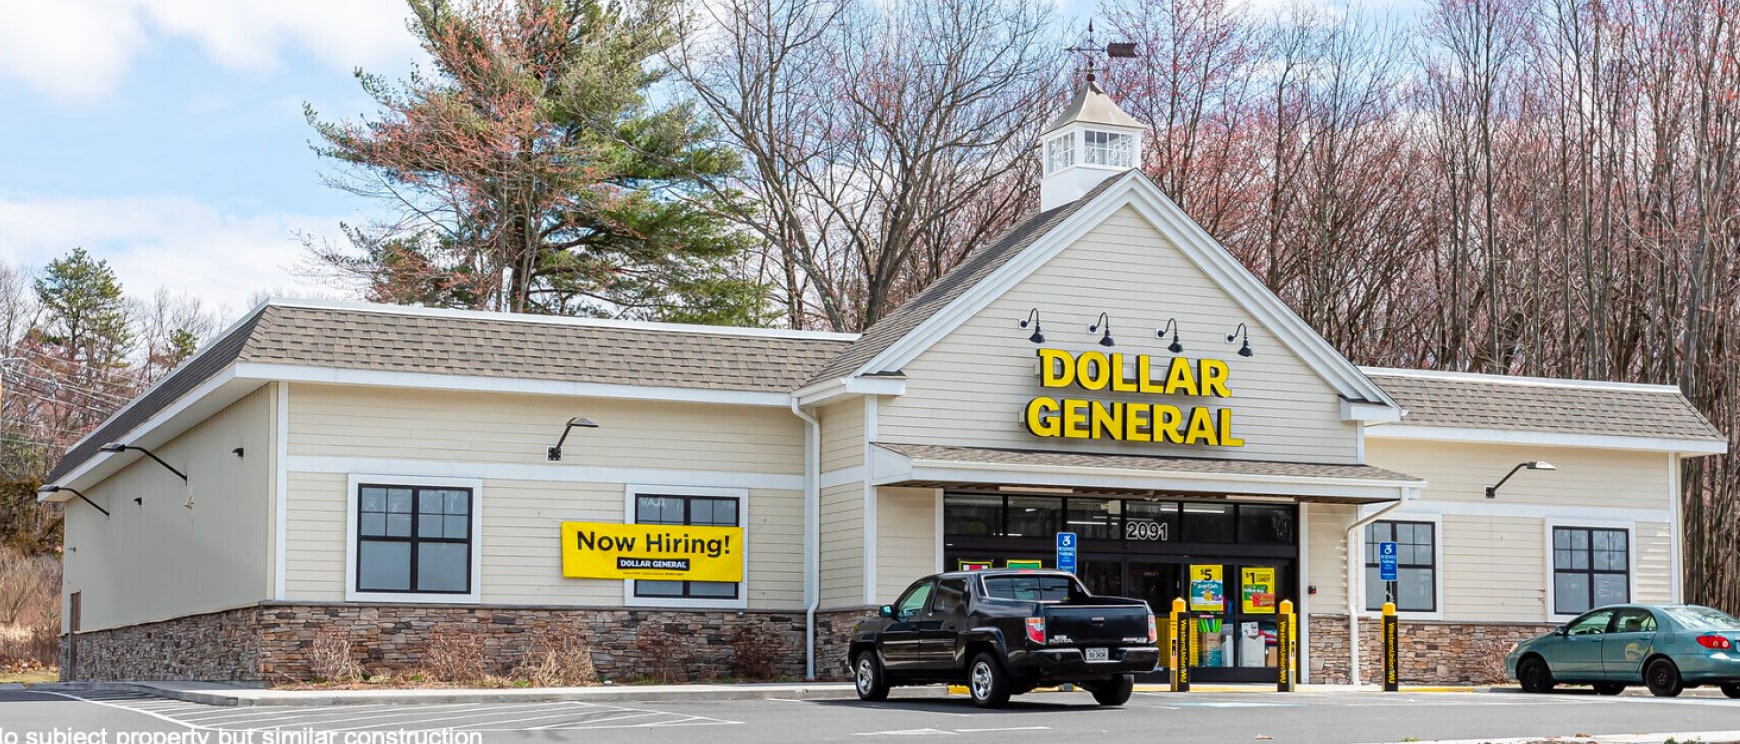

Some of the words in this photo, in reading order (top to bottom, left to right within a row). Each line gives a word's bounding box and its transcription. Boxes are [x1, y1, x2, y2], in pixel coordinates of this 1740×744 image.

[1037, 348, 1232, 398] DOLLAR
[1026, 396, 1245, 447] GENERAL
[1126, 521, 1168, 540] 2091
[577, 531, 636, 551] Now
[646, 533, 731, 558] Hiring!
[620, 559, 650, 568] DOLLAR
[652, 560, 687, 569] GENERAL
[1200, 569, 1212, 581] $5
[1246, 572, 1255, 584] $1
